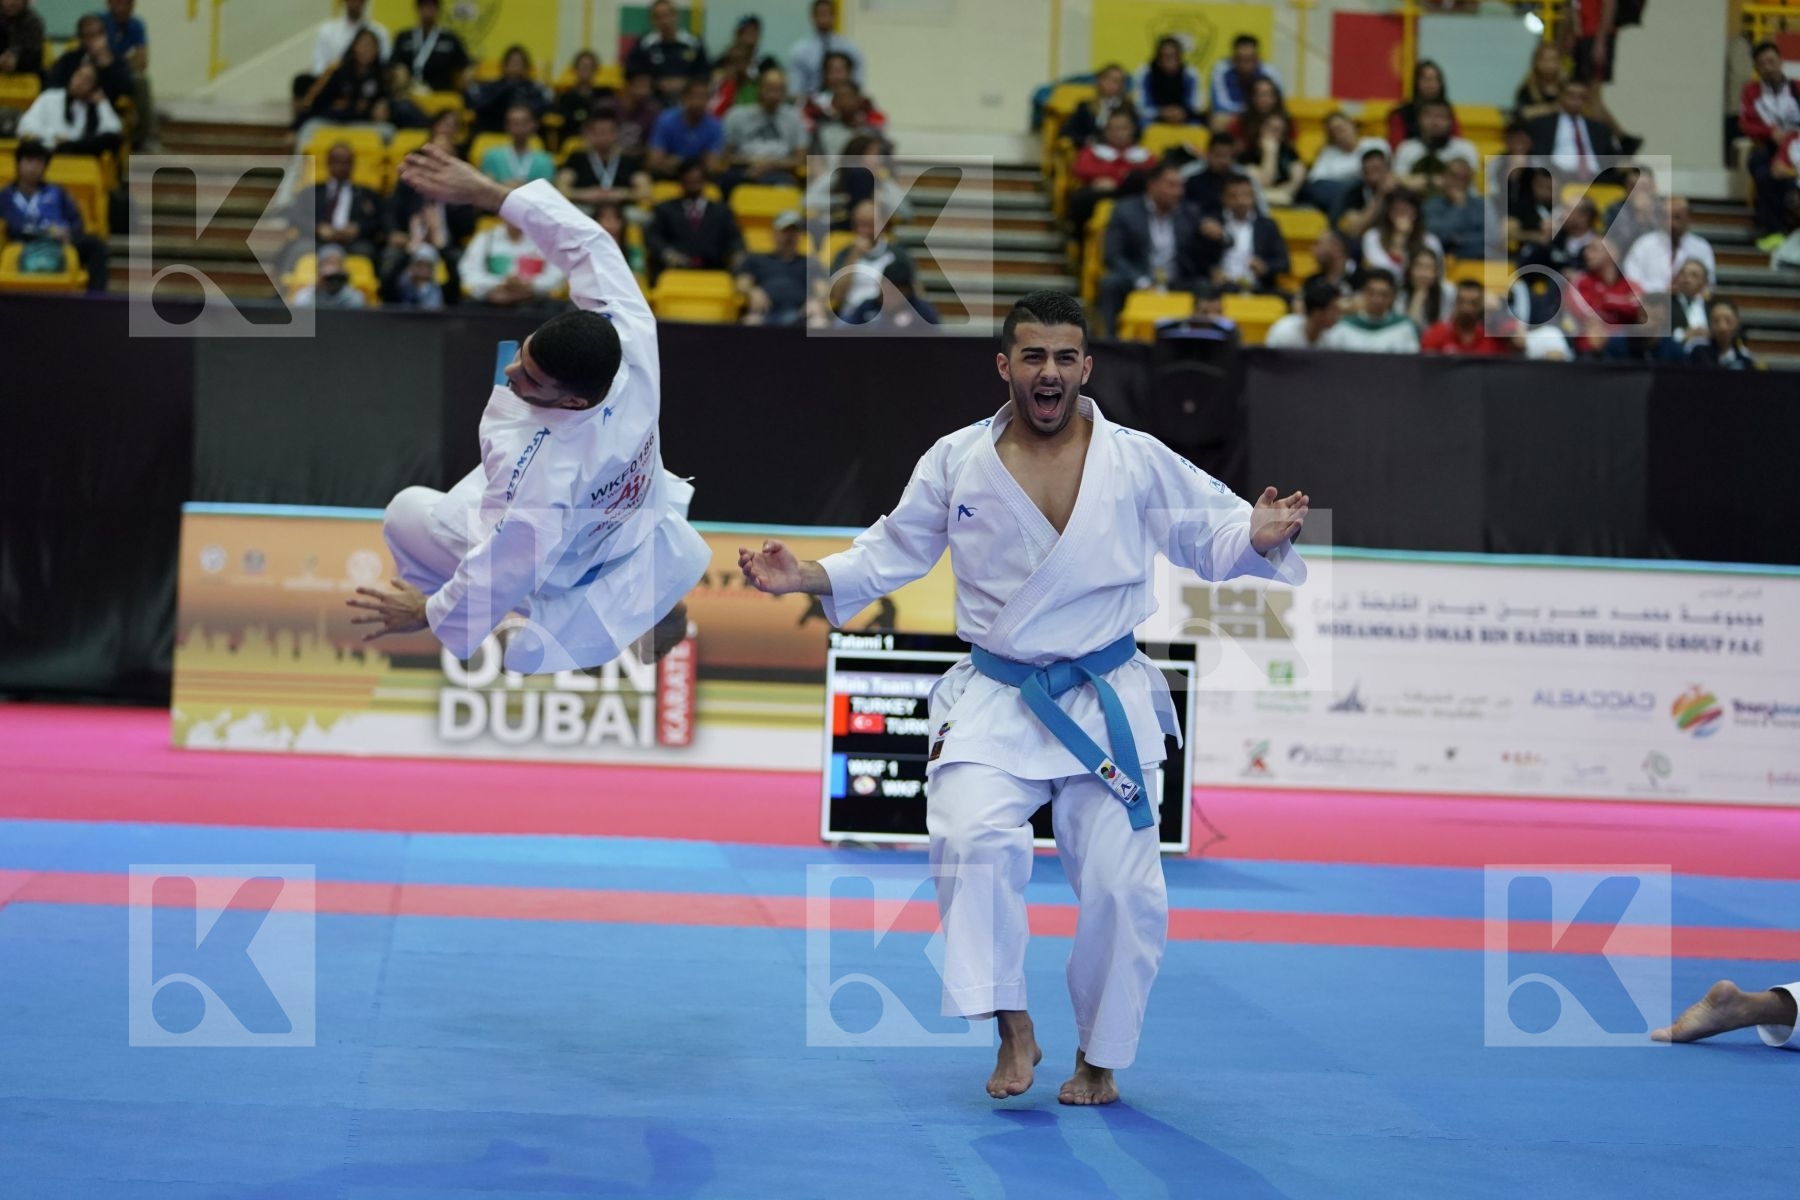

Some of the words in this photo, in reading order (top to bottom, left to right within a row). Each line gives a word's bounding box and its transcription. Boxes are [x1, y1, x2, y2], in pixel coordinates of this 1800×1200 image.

[830, 632, 882, 650] Tatami
[663, 642, 691, 744] KARATE
[850, 696, 917, 715] TURKEY
[438, 689, 657, 746] DUBAI
[847, 759, 887, 777] WKF
[888, 760, 898, 777] 1
[881, 780, 922, 798] WKF
